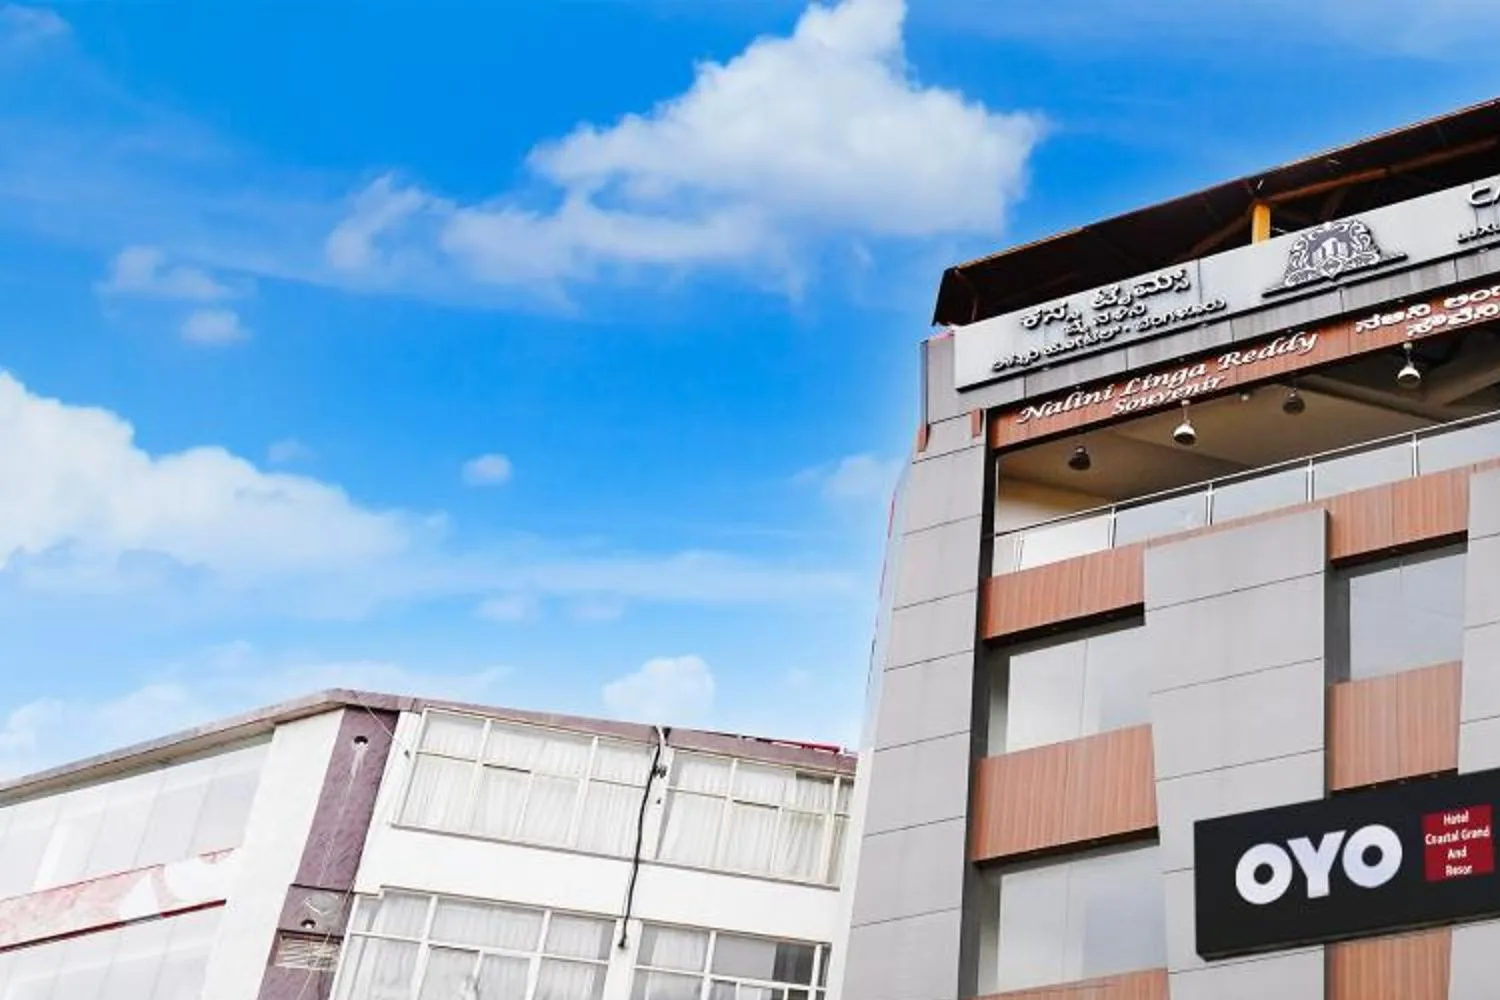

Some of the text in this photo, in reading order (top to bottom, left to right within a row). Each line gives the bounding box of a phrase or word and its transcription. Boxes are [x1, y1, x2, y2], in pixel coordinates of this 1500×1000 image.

[1016, 331, 1319, 423] Nalini Linga Reddy
[1111, 375, 1226, 416] Souvenir
[1443, 809, 1469, 826] Hotel
[1425, 825, 1490, 845] Coastal Grand
[1235, 823, 1403, 905] OYO
[1447, 845, 1467, 860] And
